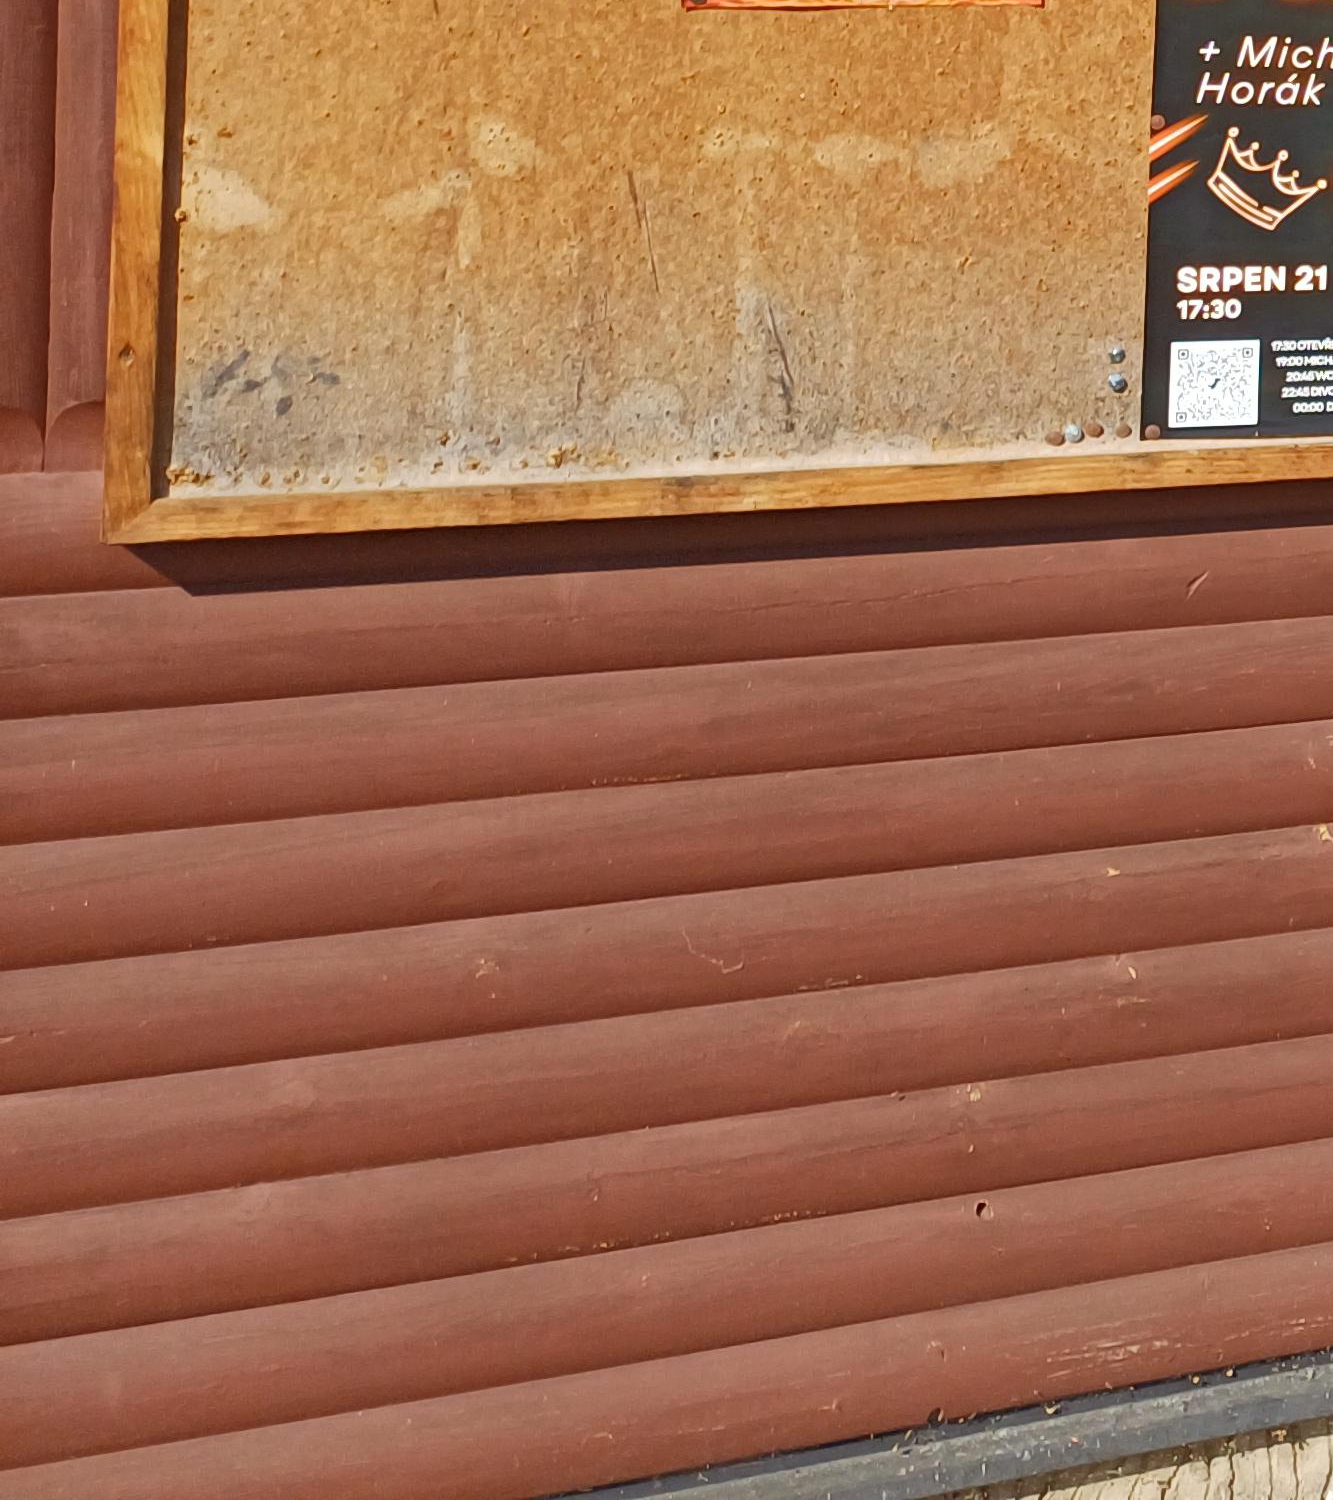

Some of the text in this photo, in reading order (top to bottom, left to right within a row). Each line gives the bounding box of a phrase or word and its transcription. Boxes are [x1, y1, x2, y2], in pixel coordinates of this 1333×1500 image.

[1195, 73, 1326, 106] Horák
[1176, 264, 1329, 293] SRPEN 21
[1176, 298, 1242, 320] 17:30
